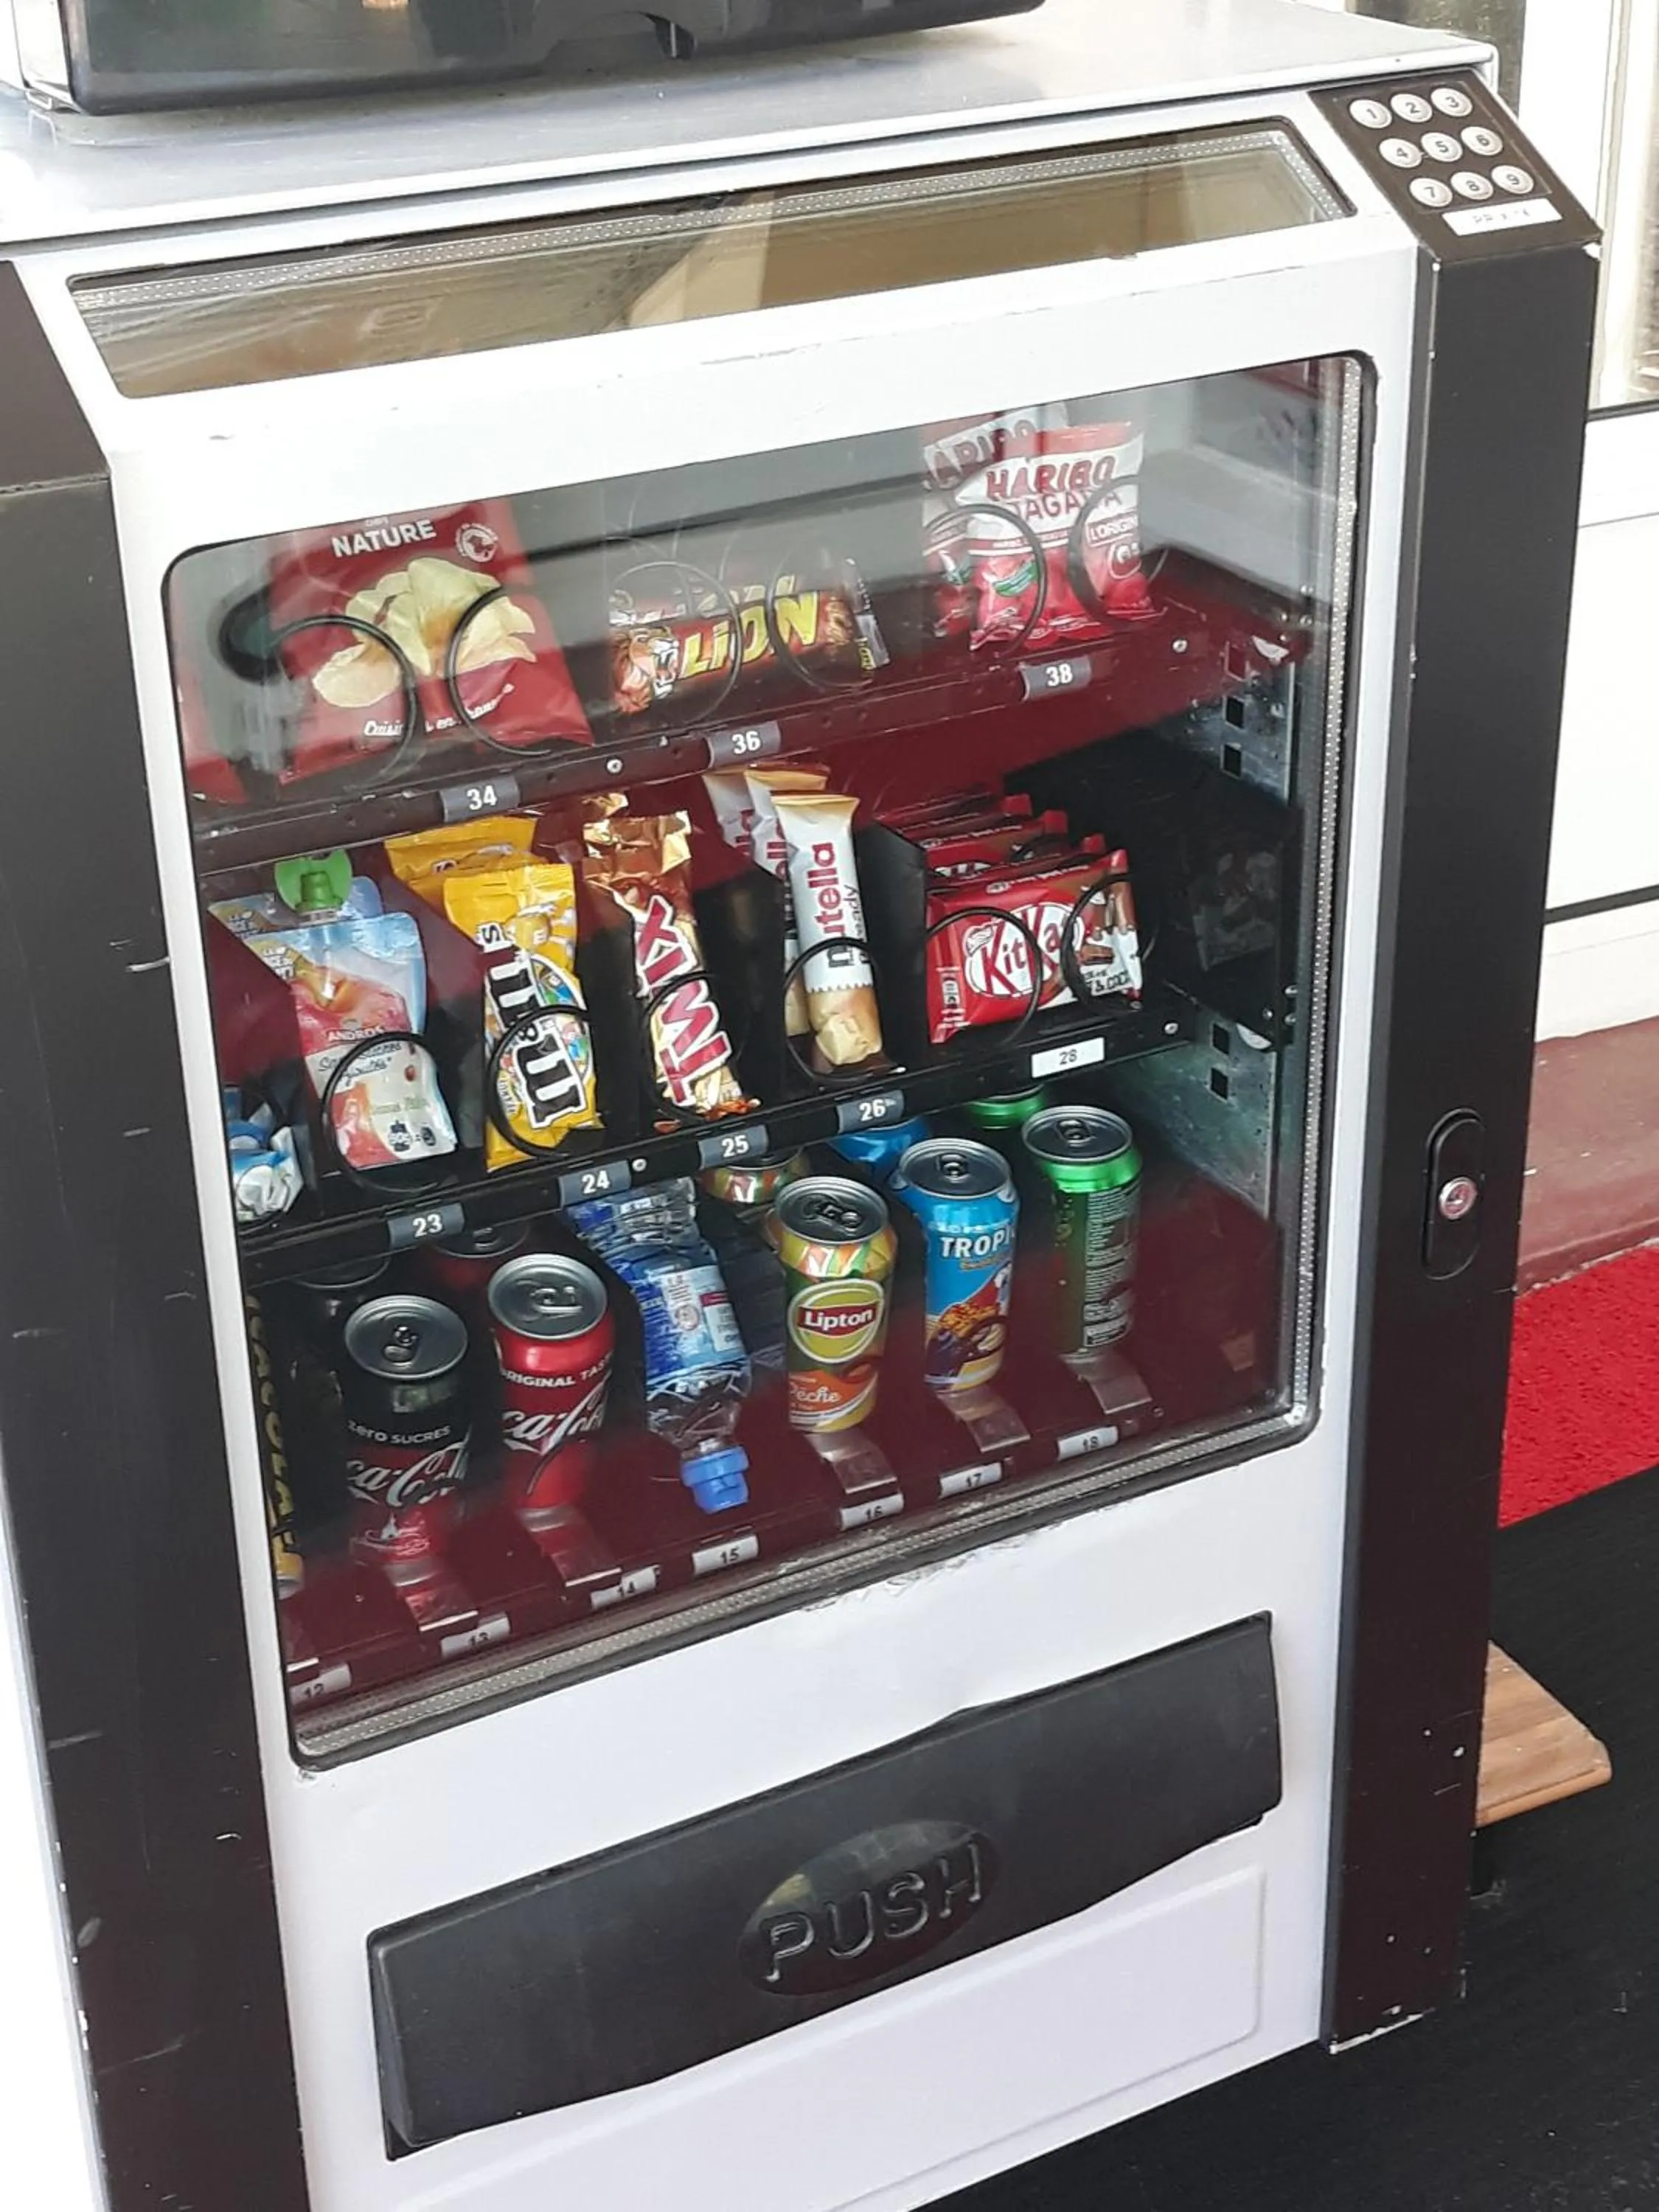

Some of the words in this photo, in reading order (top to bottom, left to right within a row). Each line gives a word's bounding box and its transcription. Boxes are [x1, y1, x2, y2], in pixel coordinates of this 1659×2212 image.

[987, 455, 1118, 502] HARIBO
[332, 519, 437, 558] NATURE
[679, 591, 820, 679] LION
[1046, 663, 1074, 687] 38
[732, 731, 761, 754] 36
[466, 785, 498, 810] 34
[638, 896, 730, 1105] TWIX
[1059, 1048, 1078, 1066] 28
[860, 1101, 885, 1122] 26
[721, 1134, 749, 1158] 25
[581, 1169, 610, 1194] 24
[412, 1214, 443, 1238] 23
[804, 1308, 874, 1332] Lipton
[501, 1367, 576, 1388] RIGINAL
[1081, 1436, 1100, 1453] 18
[964, 1472, 983, 1489] 17
[864, 1505, 885, 1520] 16
[719, 1547, 741, 1565] 15
[616, 1581, 636, 1598] 14
[467, 1631, 490, 1647] 13
[765, 1837, 981, 1983] PUSH
